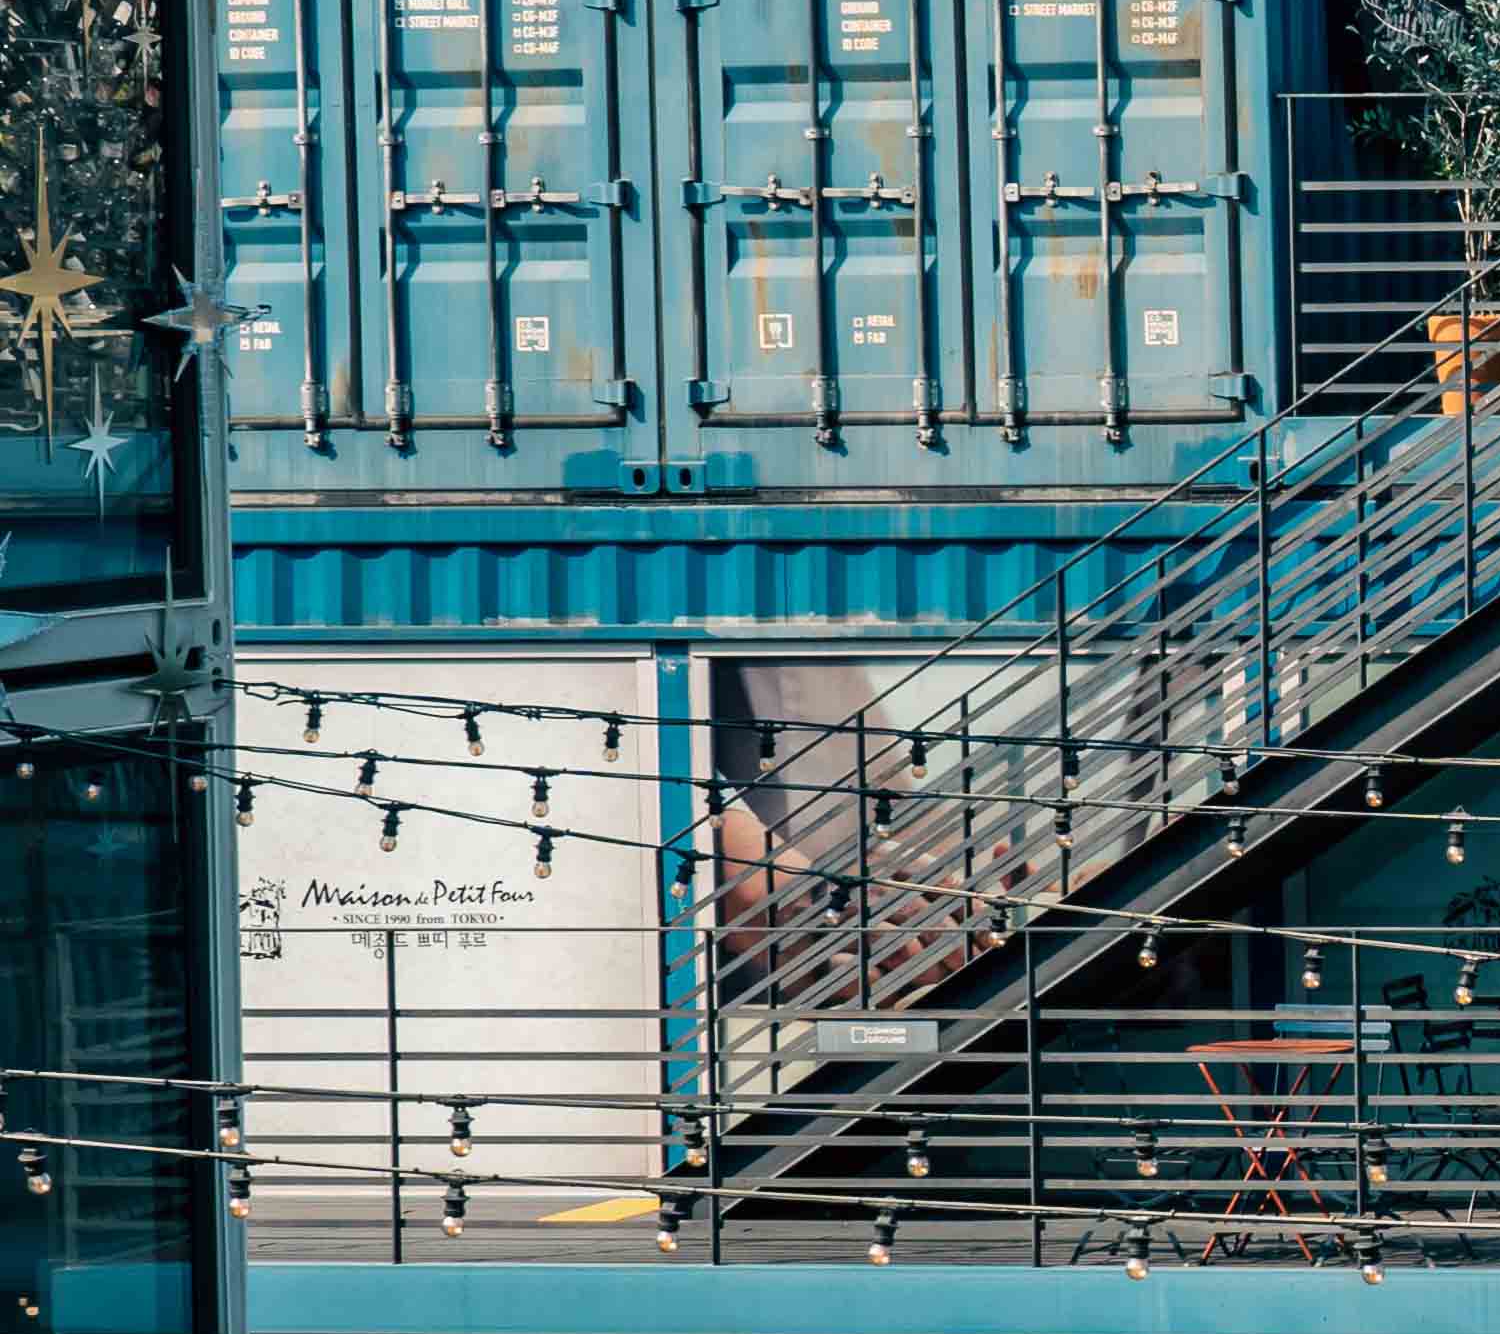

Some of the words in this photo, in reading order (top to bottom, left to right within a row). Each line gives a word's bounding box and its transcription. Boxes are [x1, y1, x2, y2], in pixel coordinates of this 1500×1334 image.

[302, 879, 413, 908] Maison
[433, 880, 487, 906] Petit
[492, 880, 538, 905] Four
[344, 914, 383, 925] SINCE
[385, 914, 412, 925] 1990
[417, 913, 446, 925] from
[453, 914, 498, 925] TOKYO
[352, 931, 386, 960] 메종
[418, 931, 450, 949] 쁘띠
[460, 932, 488, 949] 푸르
